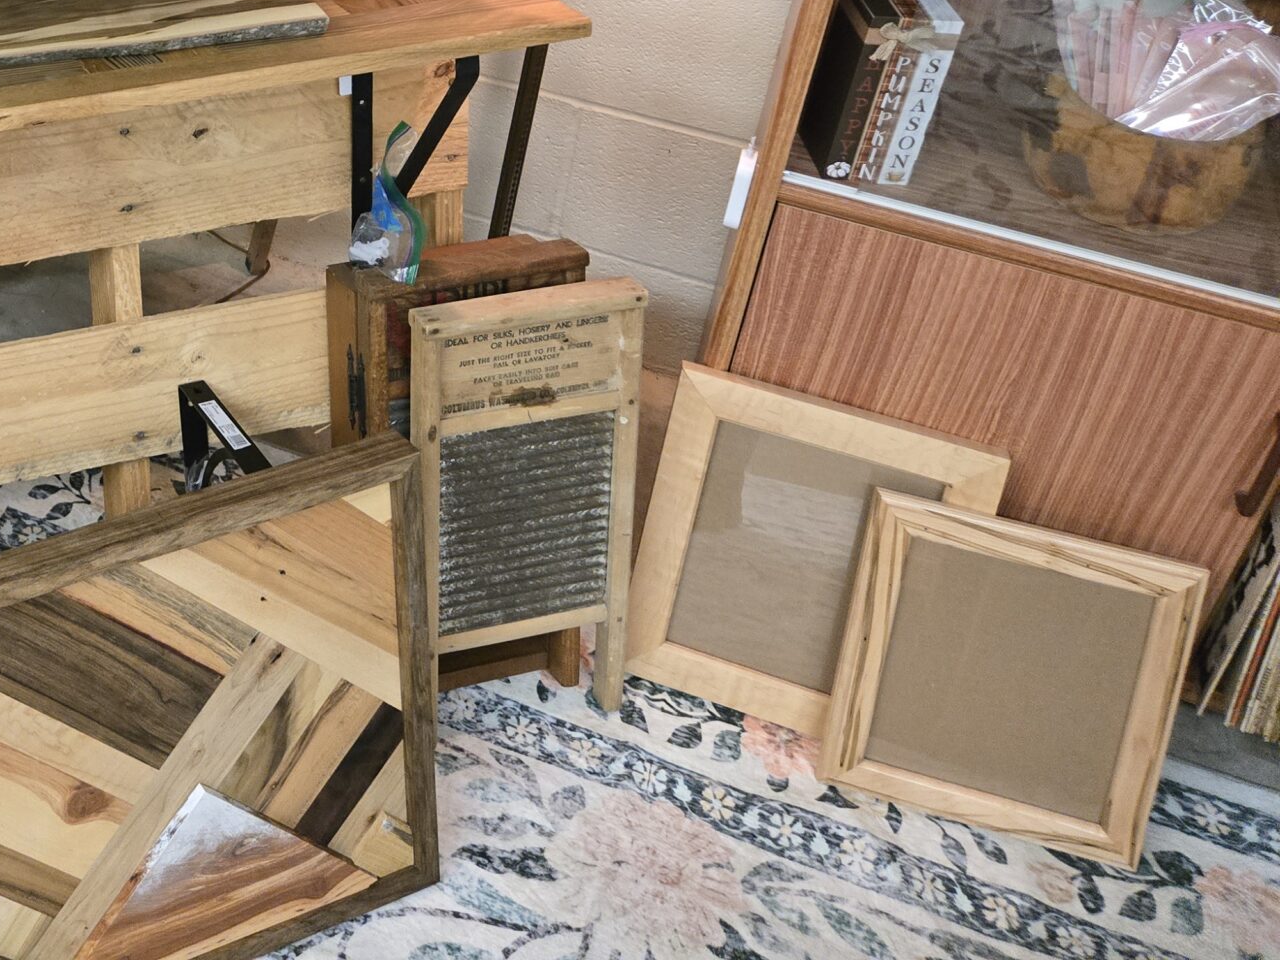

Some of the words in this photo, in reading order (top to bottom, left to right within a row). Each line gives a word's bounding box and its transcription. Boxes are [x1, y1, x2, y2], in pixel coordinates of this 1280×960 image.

[858, 55, 912, 182] PUMPKIN
[888, 57, 942, 170] SEASON
[445, 337, 468, 348] IDEAL
[473, 334, 488, 343] FOR
[493, 329, 514, 341] SILKS,
[519, 324, 551, 336] HOSIERY
[556, 320, 572, 330] AND
[491, 341, 502, 350] OR
[507, 331, 566, 347] HANDKERCHIEFS
[460, 359, 476, 368] JUST
[494, 353, 514, 362] RIGHT
[517, 350, 531, 358] SIZE
[513, 358, 522, 366] OR
[525, 352, 560, 364] LAVATORY
[526, 368, 541, 376] INTO
[442, 399, 485, 415] COLUMBUS
